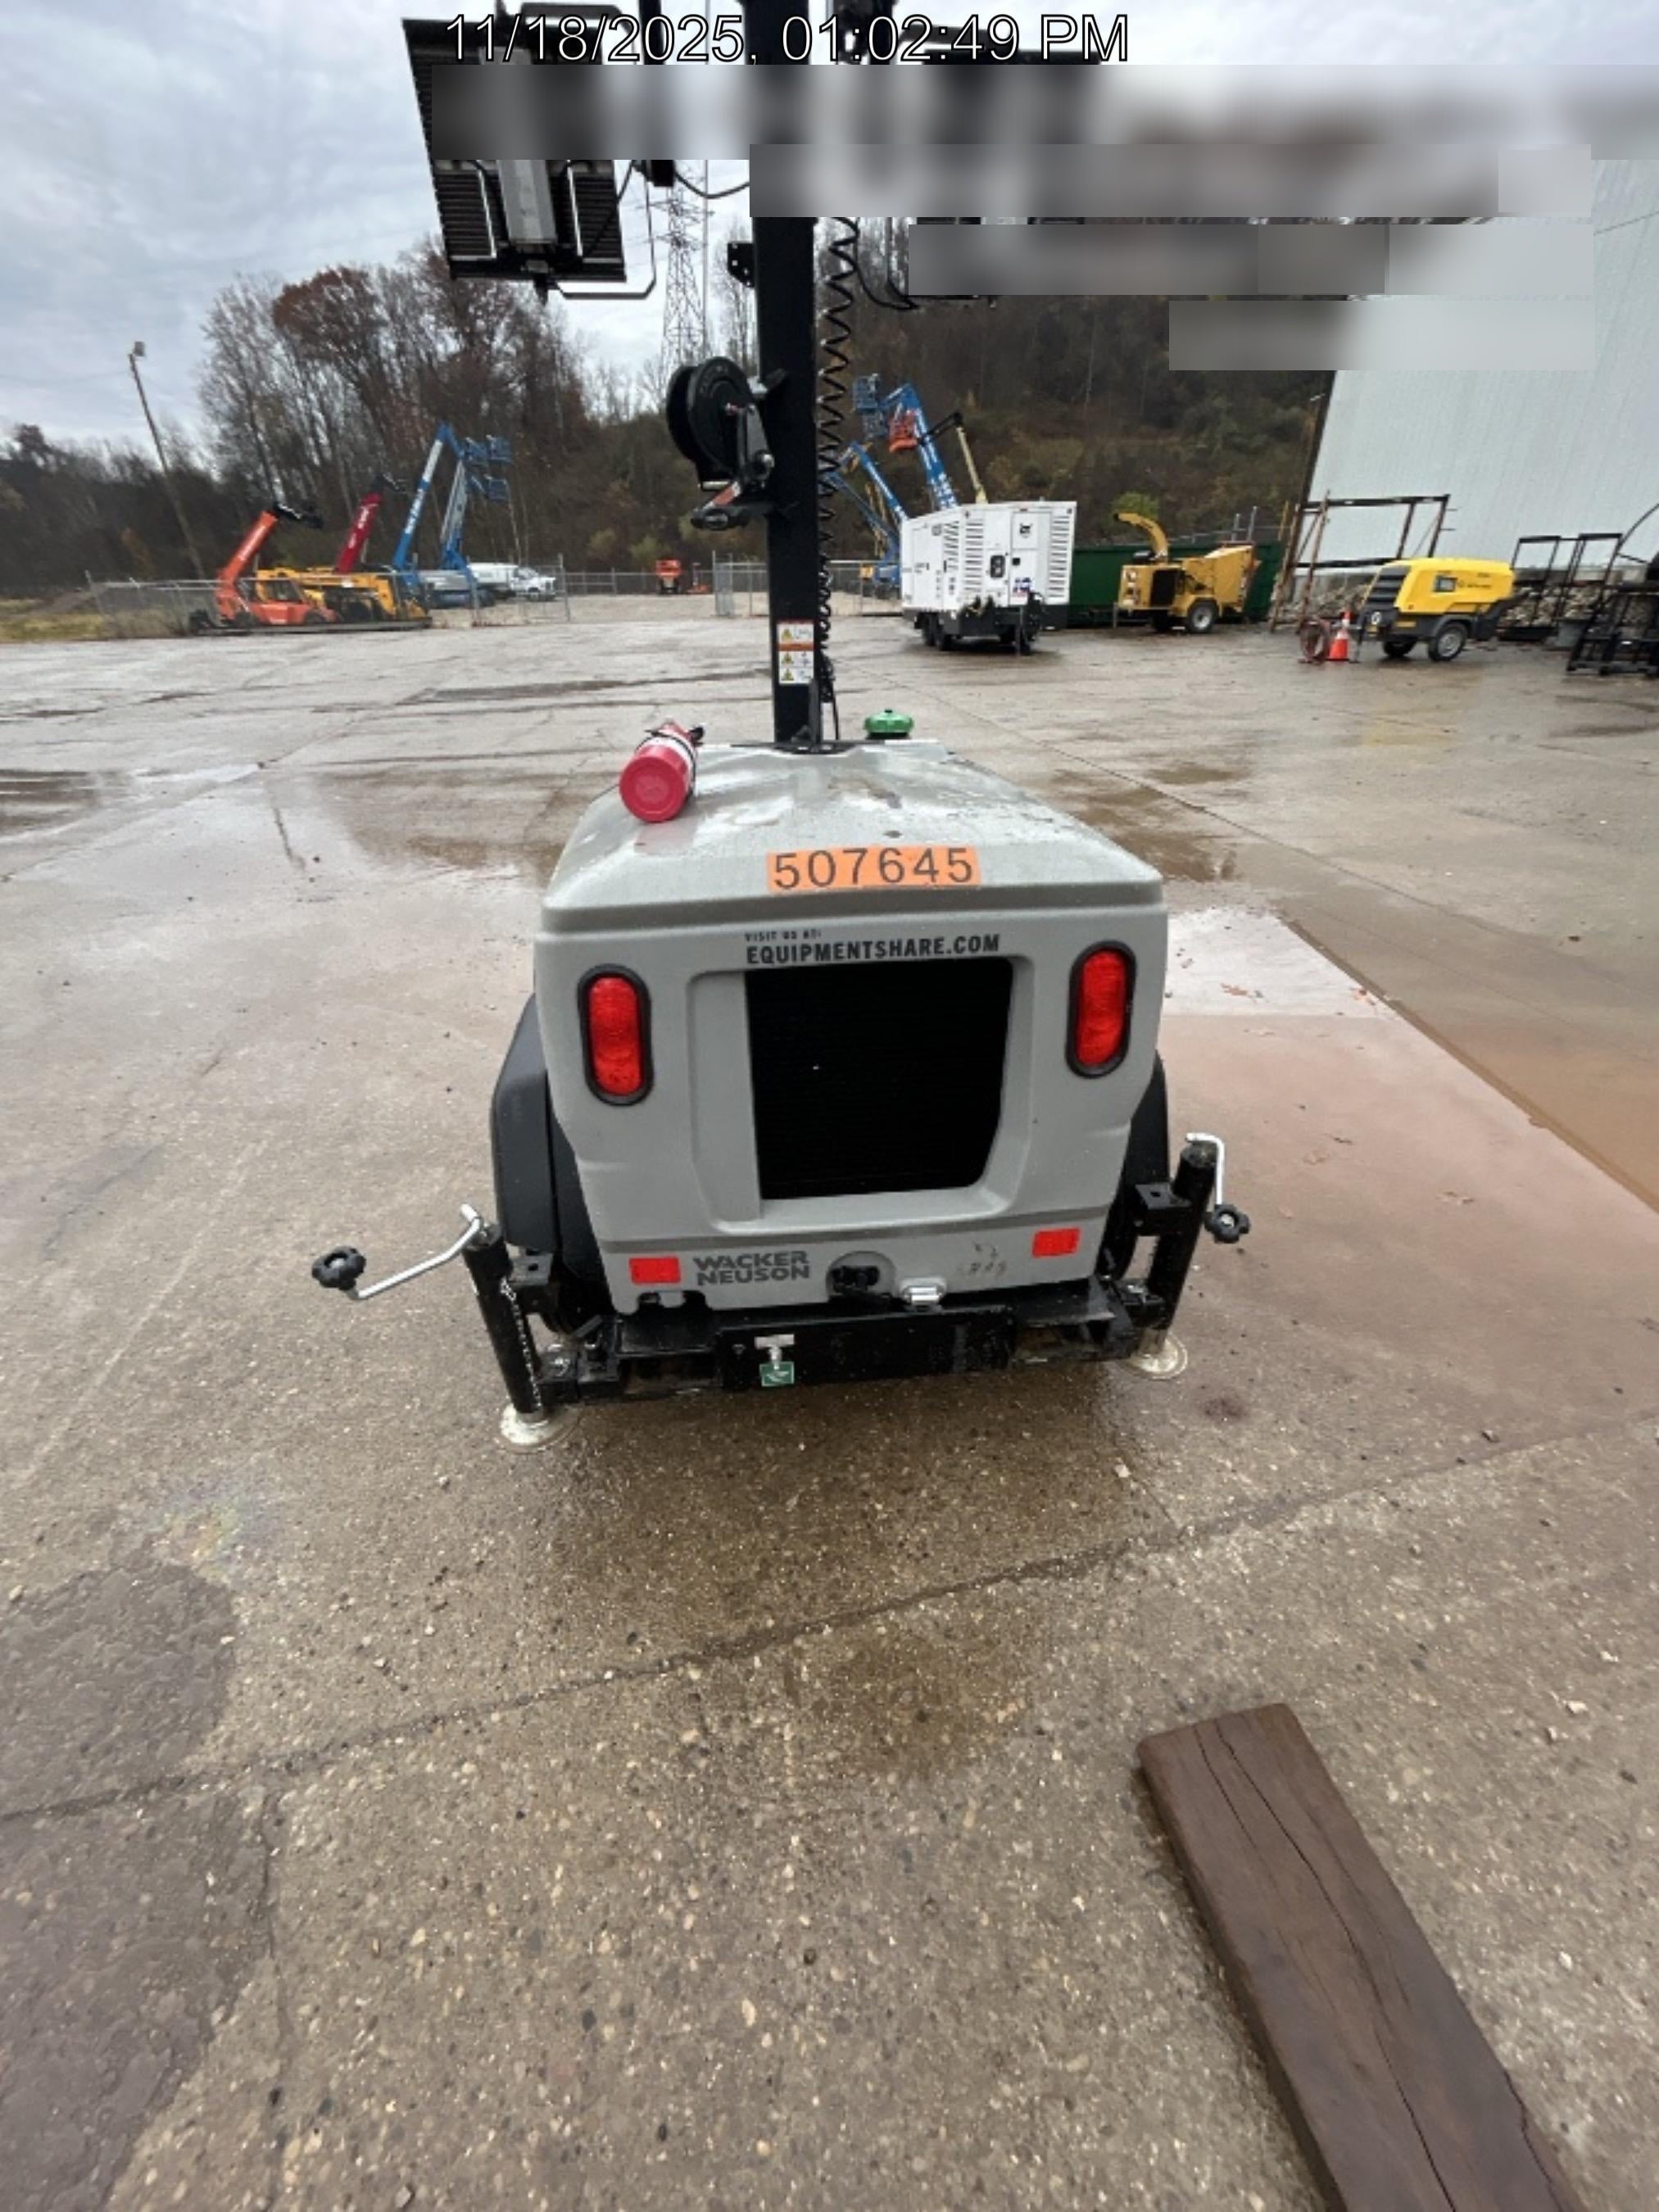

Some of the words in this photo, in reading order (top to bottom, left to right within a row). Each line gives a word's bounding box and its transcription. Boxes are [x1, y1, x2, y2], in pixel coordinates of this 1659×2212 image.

[774, 848, 972, 889] 507645
[747, 934, 999, 963] EQUIPMENTSHARE.COM
[693, 1251, 808, 1271] WACKER
[697, 1264, 809, 1285] NEUSON
